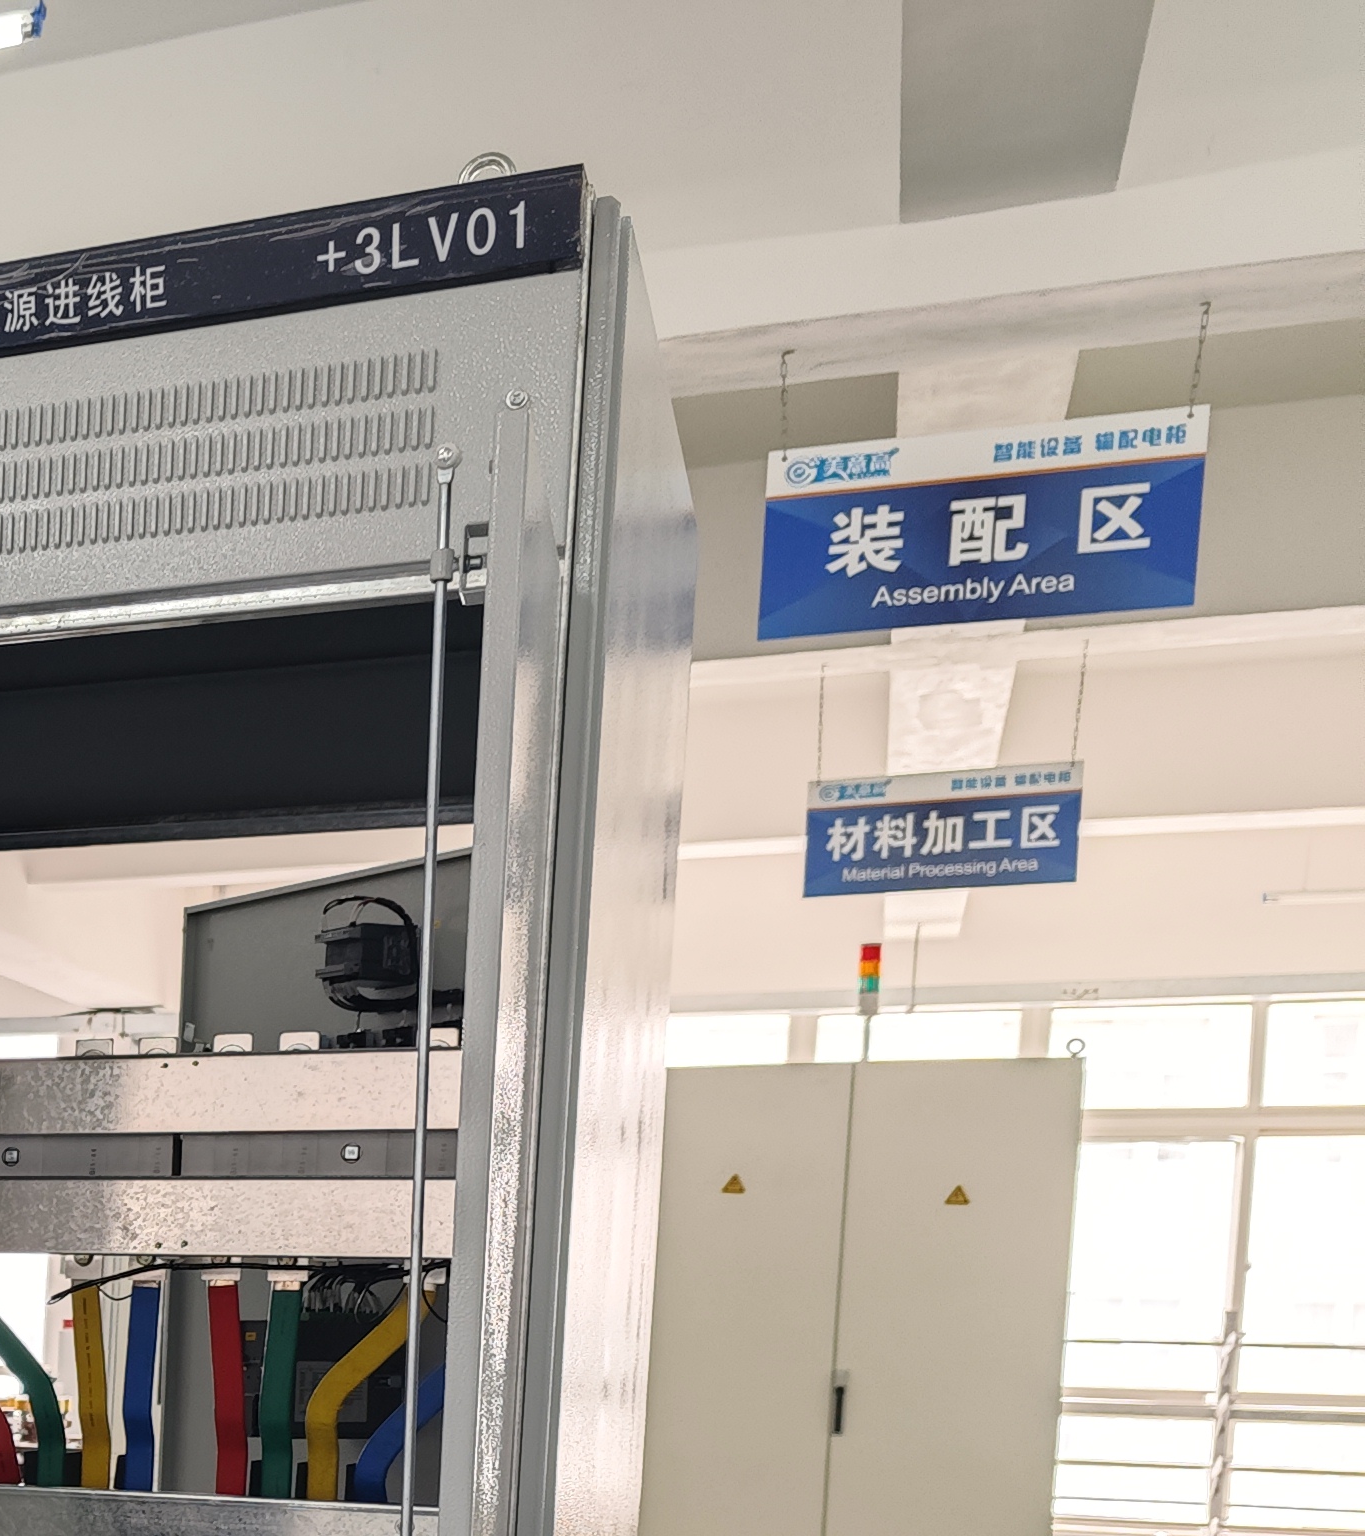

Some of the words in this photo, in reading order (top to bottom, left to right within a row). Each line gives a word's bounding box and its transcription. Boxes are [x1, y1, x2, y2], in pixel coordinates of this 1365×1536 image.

[315, 199, 528, 276] +3LV01
[825, 482, 1152, 578] 装配区
[871, 577, 1006, 608] Assembly
[1009, 573, 1076, 597] Area
[826, 804, 1061, 862] 材料加工区
[842, 863, 904, 883] Material
[909, 860, 997, 879] Processing
[999, 858, 1039, 872] Area
